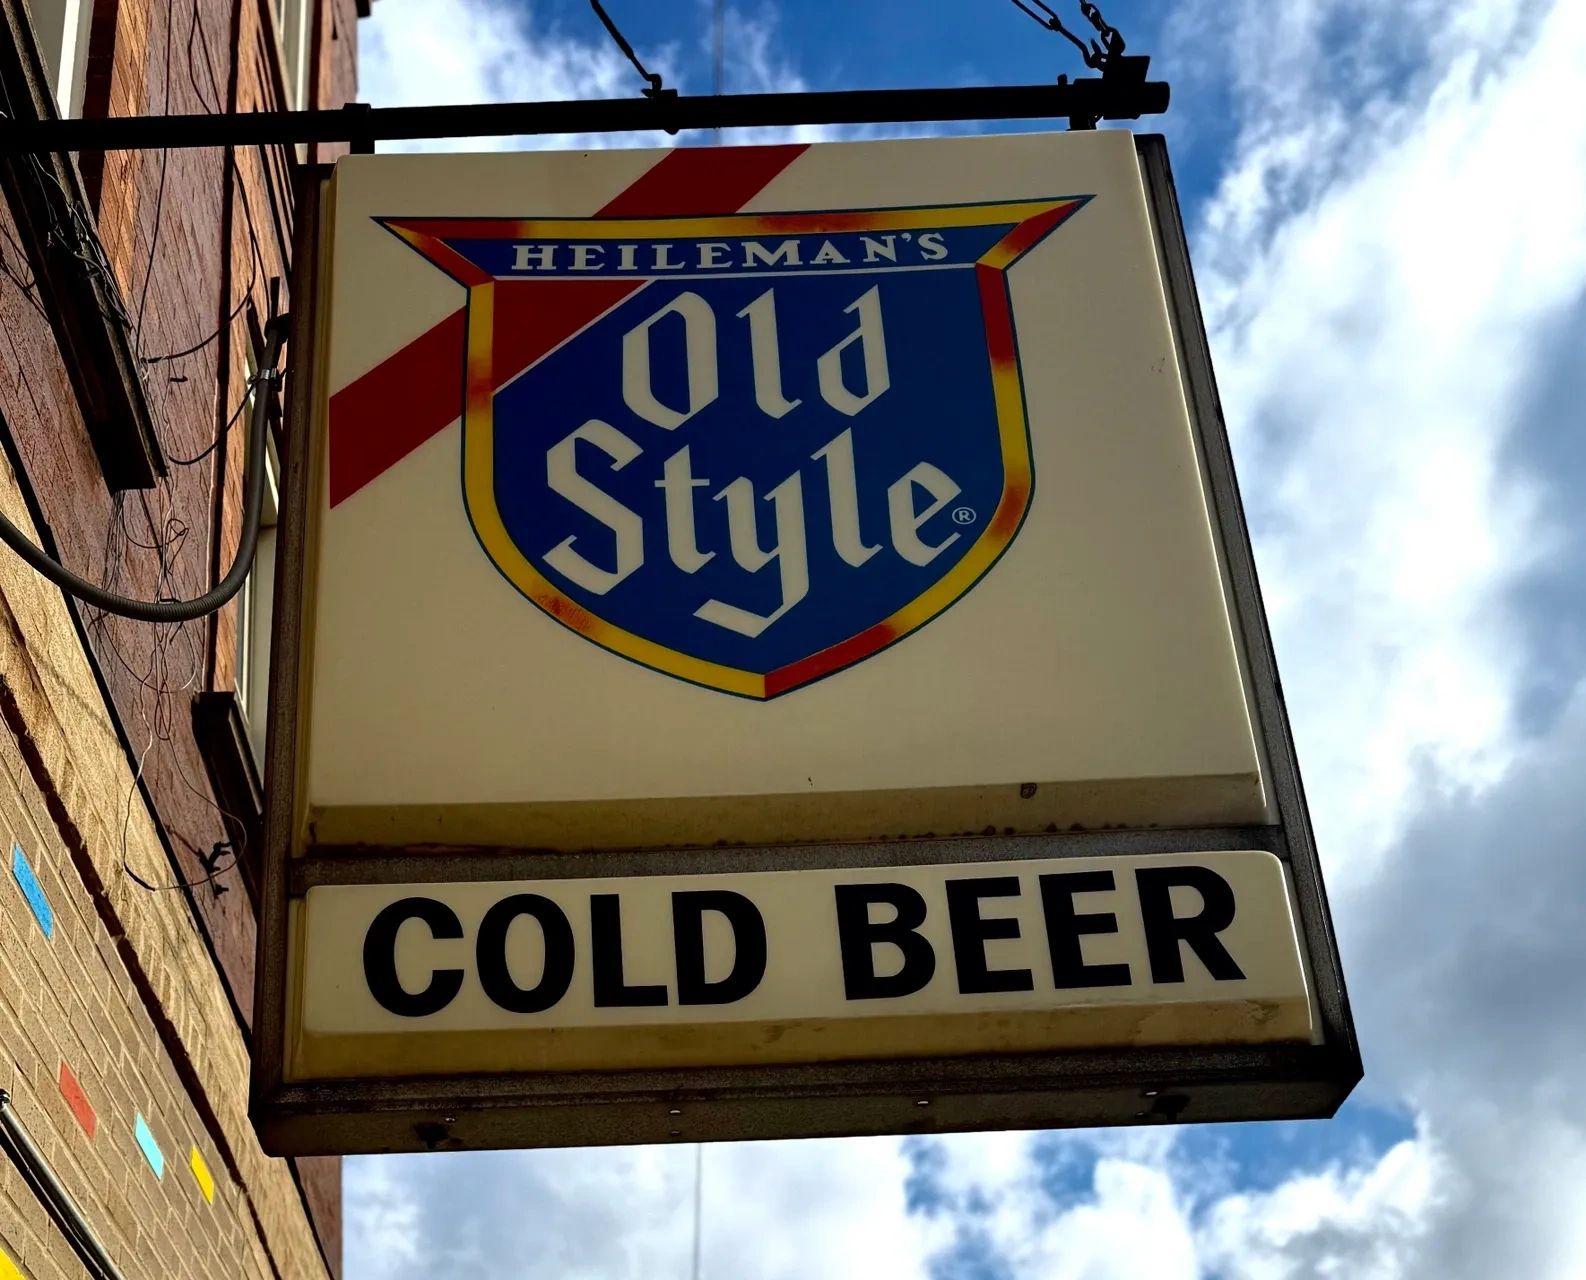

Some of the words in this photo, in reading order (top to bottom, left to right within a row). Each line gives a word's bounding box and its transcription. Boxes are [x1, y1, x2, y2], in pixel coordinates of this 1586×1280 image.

[511, 231, 949, 271] HEILEMAN'S
[622, 284, 891, 431] Old
[541, 418, 962, 639] Style
[362, 890, 768, 1018] COLD
[834, 865, 1247, 1001] BEER
